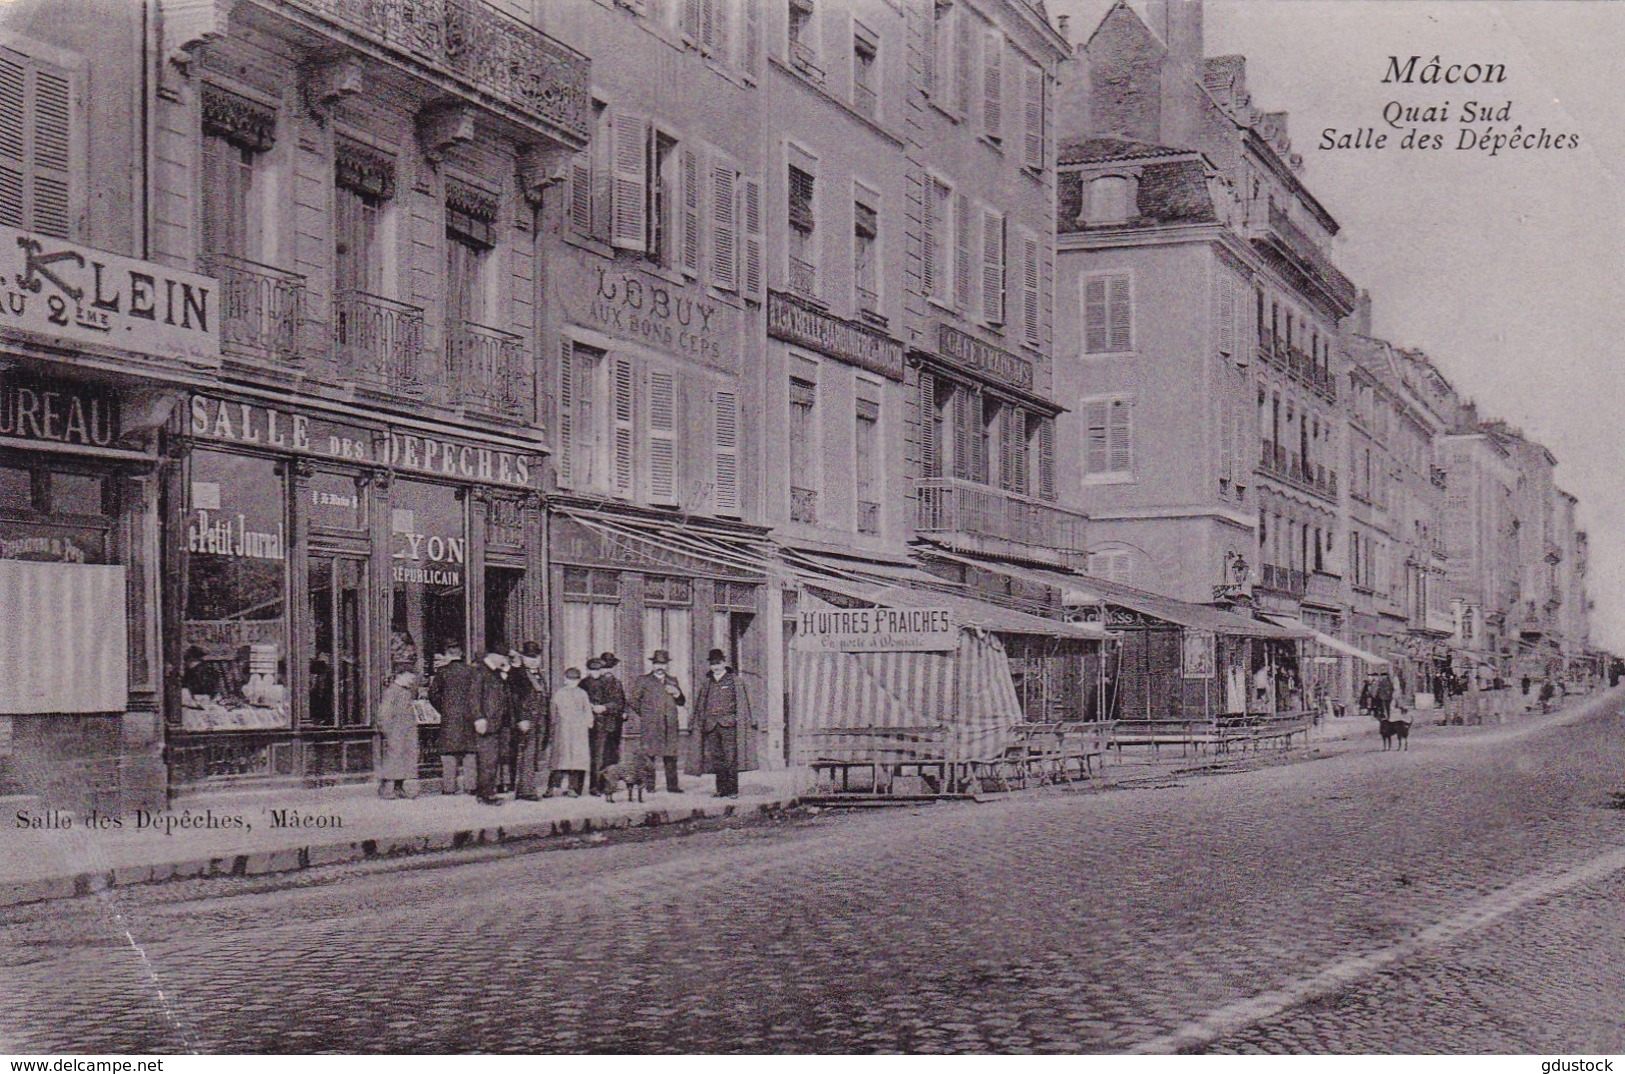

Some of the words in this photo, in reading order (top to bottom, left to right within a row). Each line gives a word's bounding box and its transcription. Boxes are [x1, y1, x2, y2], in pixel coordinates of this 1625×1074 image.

[0, 291, 27, 316] U
[16, 236, 209, 333] KLEIN
[590, 301, 622, 328] AUX
[192, 394, 310, 450] SALLE
[330, 434, 365, 459] DES
[197, 510, 234, 556] Petit
[235, 514, 285, 560] Journal
[800, 610, 869, 637] HUITRES
[872, 609, 949, 635] FRAICHES
